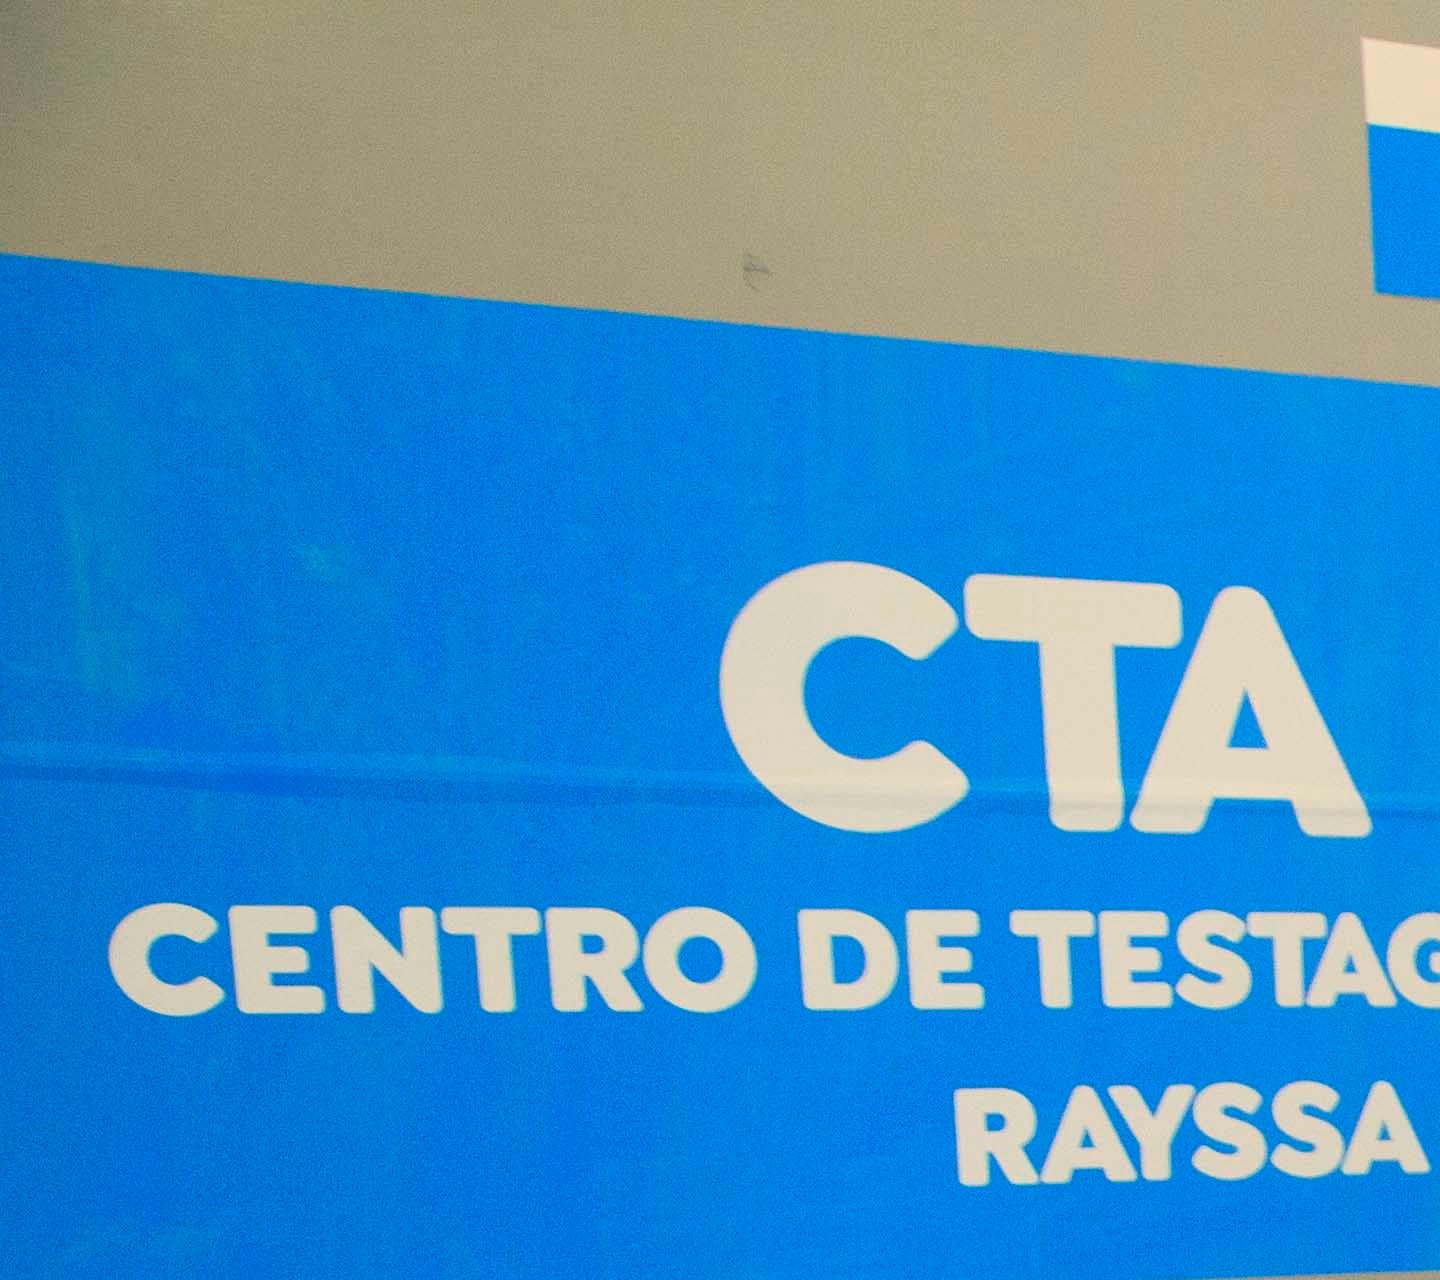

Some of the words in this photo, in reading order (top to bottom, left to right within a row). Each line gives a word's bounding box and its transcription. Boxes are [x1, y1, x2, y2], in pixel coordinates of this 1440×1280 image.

[719, 561, 1372, 838] CTA
[108, 903, 758, 1017] CENTRO
[797, 908, 985, 1011] DE
[953, 1080, 1430, 1187] RAYSSA
